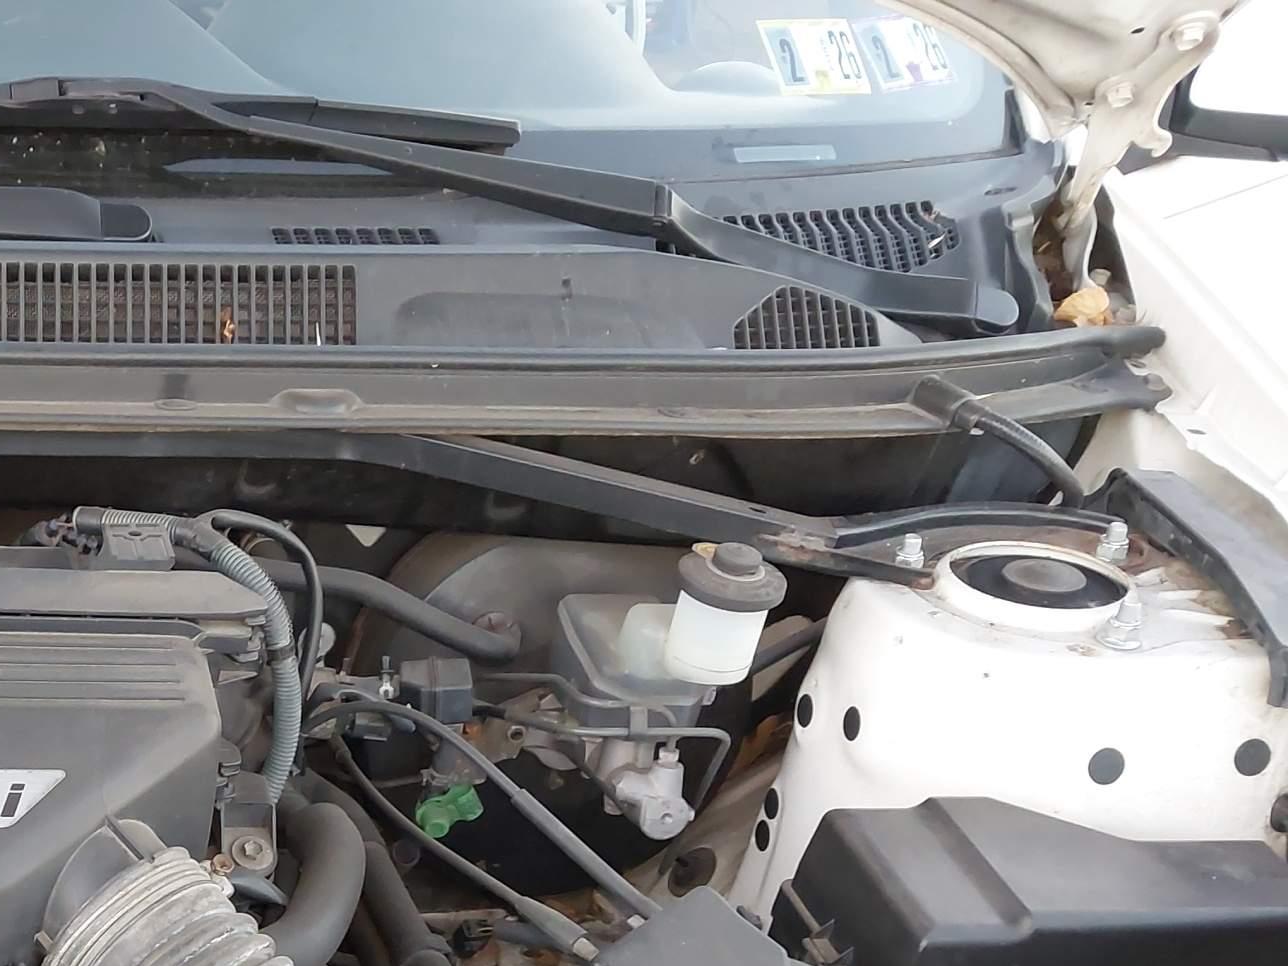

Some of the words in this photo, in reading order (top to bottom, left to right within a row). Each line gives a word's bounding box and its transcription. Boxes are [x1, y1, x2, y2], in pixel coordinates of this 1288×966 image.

[778, 38, 805, 82] 2
[827, 30, 862, 80] 26
[871, 35, 900, 79] 2
